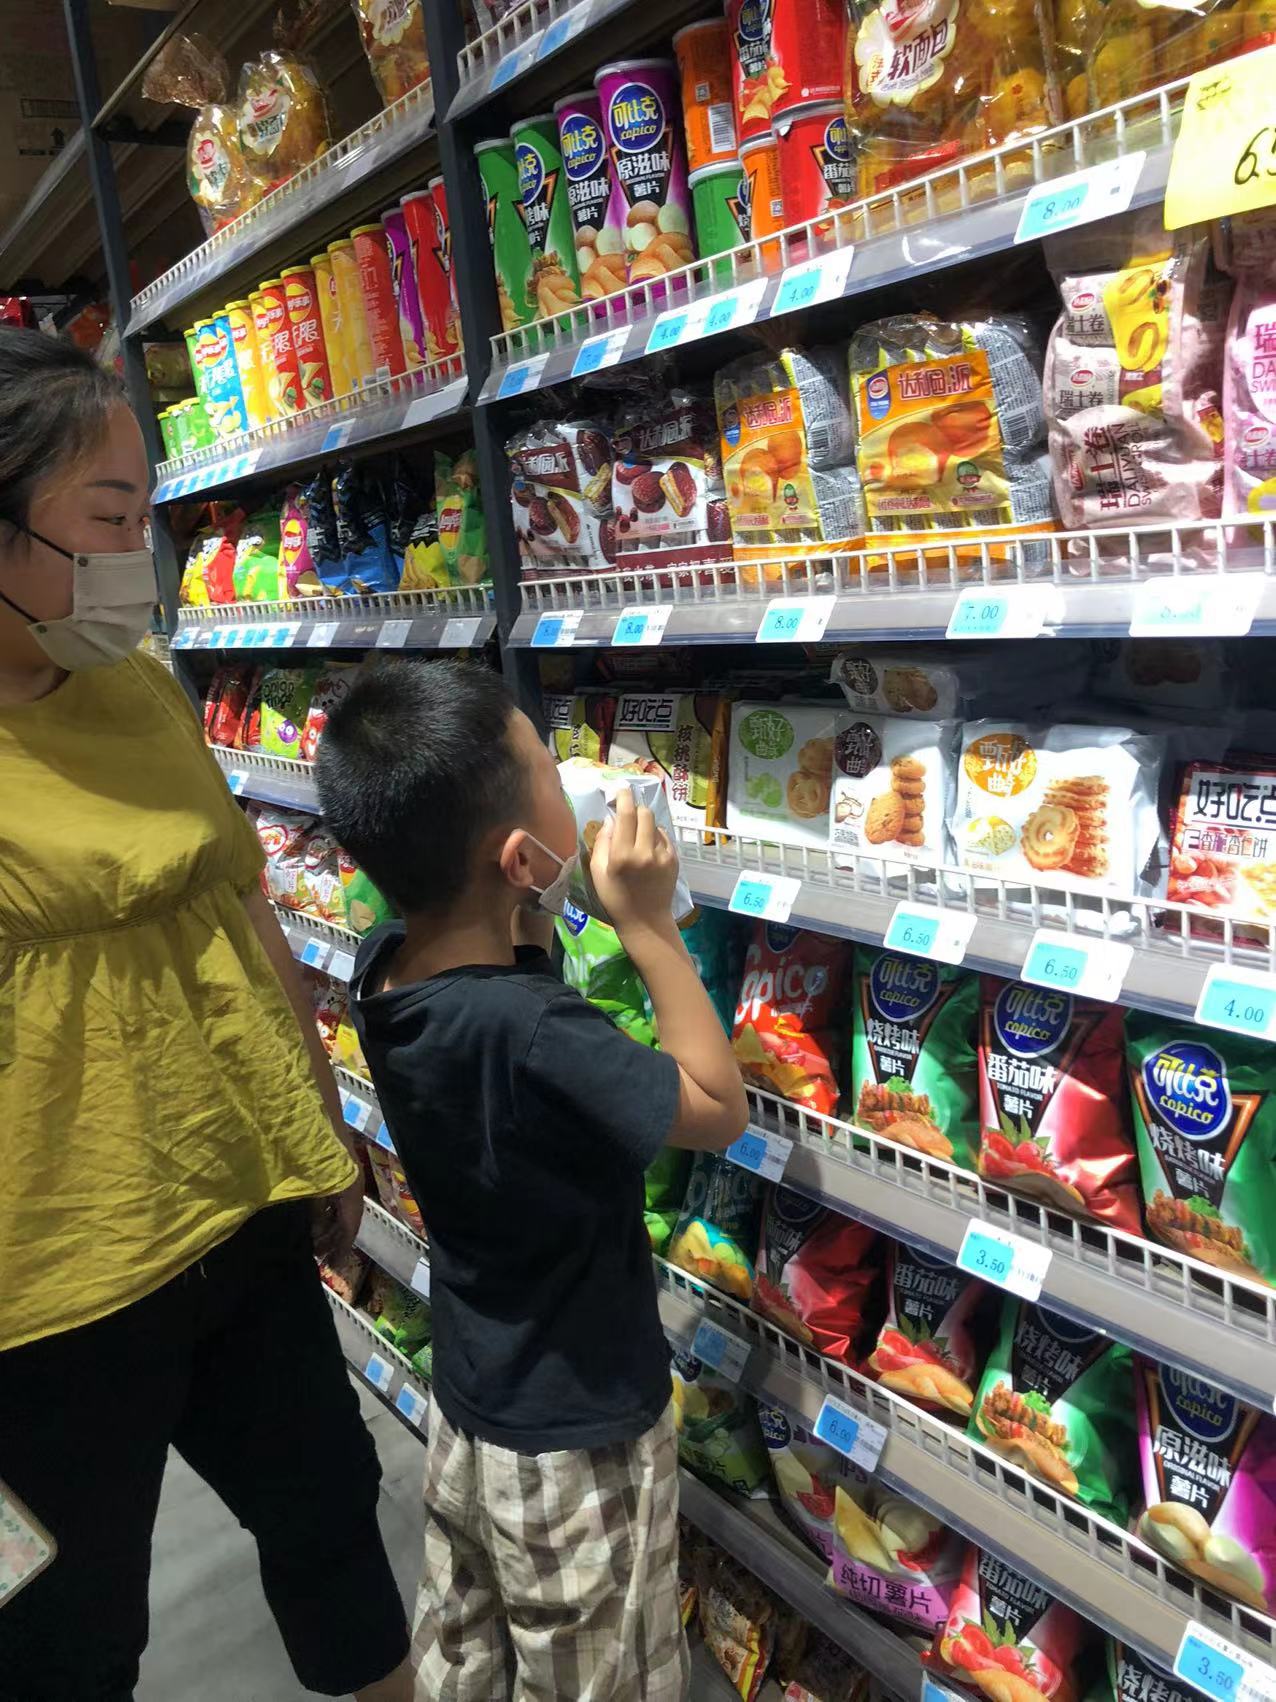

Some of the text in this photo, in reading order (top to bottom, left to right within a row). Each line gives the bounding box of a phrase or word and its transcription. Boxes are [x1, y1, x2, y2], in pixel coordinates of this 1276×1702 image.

[611, 96, 659, 129] 可比克
[561, 125, 599, 158] 可比克
[616, 150, 671, 180] 原滋味
[633, 181, 661, 197] 薯片
[576, 206, 599, 223] 薯片
[775, 614, 799, 632] 8.00
[965, 604, 999, 621] 7.00
[619, 698, 673, 723] 好吃点
[743, 892, 764, 909] 6.50
[902, 927, 931, 947] 6.50
[879, 957, 932, 993] 可比克
[1043, 958, 1078, 980] 6.50
[1004, 986, 1063, 1026] 可比克
[1223, 998, 1265, 1024] 4.00
[867, 1017, 921, 1055] 烧烤味
[880, 1055, 906, 1076] 薯片
[987, 1053, 1059, 1094] 番茄味
[1153, 1053, 1219, 1106] 可比克
[1003, 1095, 1034, 1119] 薯片
[1149, 1123, 1226, 1181] 烧烤味
[976, 1249, 1005, 1275] 3.50
[894, 1262, 960, 1300] 番茄味
[1015, 1321, 1085, 1381] 烧烤味
[1153, 1424, 1232, 1488] 原滋味
[1170, 1475, 1210, 1508] 薯片
[840, 1563, 932, 1614] 纯切薯片
[1198, 1656, 1234, 1690] 3.50
